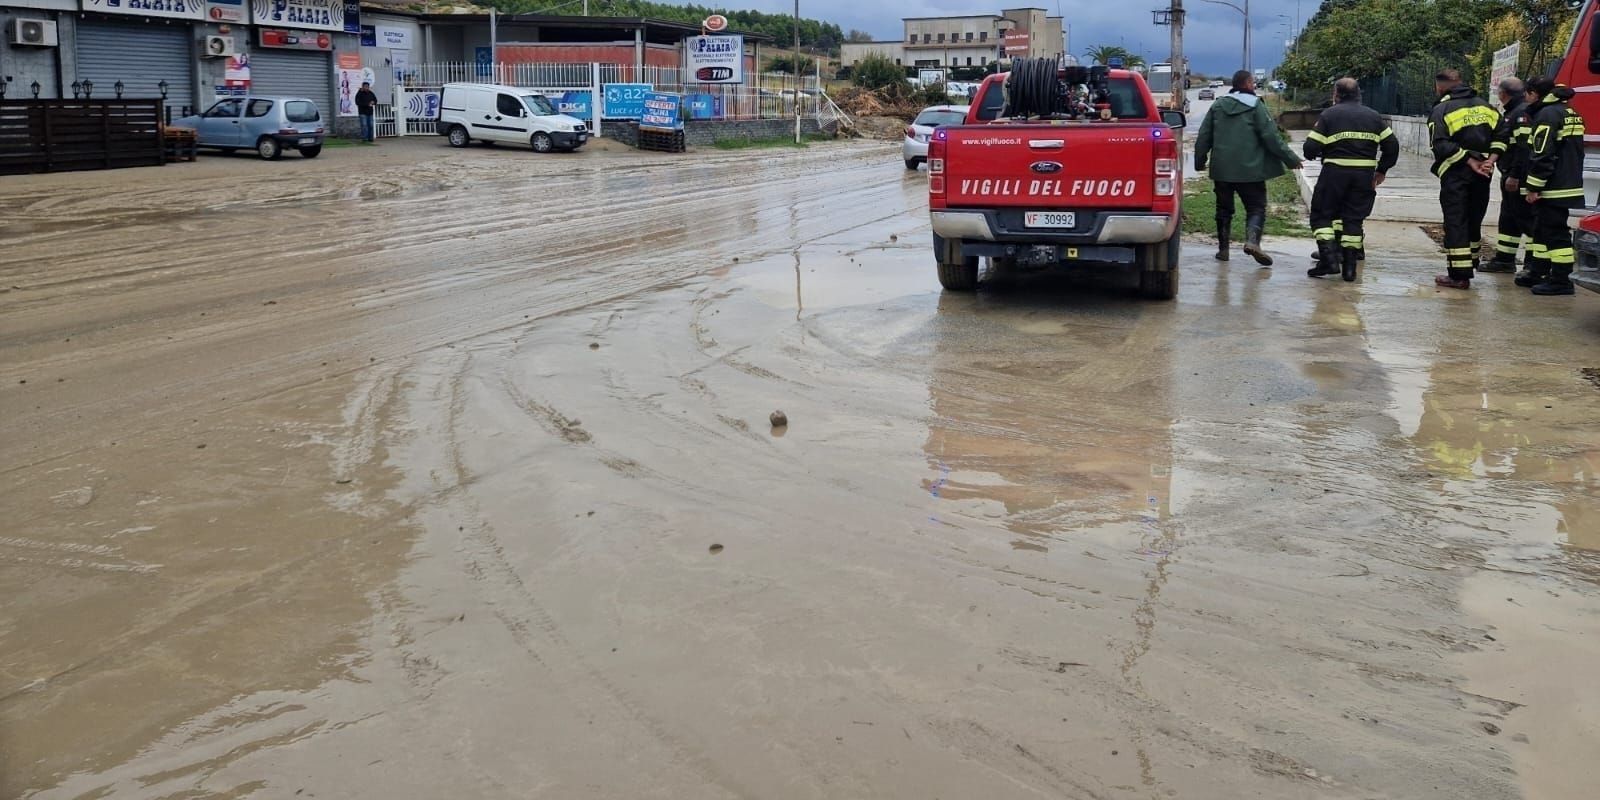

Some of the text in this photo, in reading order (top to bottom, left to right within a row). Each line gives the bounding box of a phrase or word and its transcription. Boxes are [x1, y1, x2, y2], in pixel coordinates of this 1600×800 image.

[107, 0, 185, 12] ALAIA
[712, 69, 730, 78] TIM
[961, 179, 1137, 197] VIGILI DEL FUOCO
[1027, 214, 1073, 225] VF 30992
